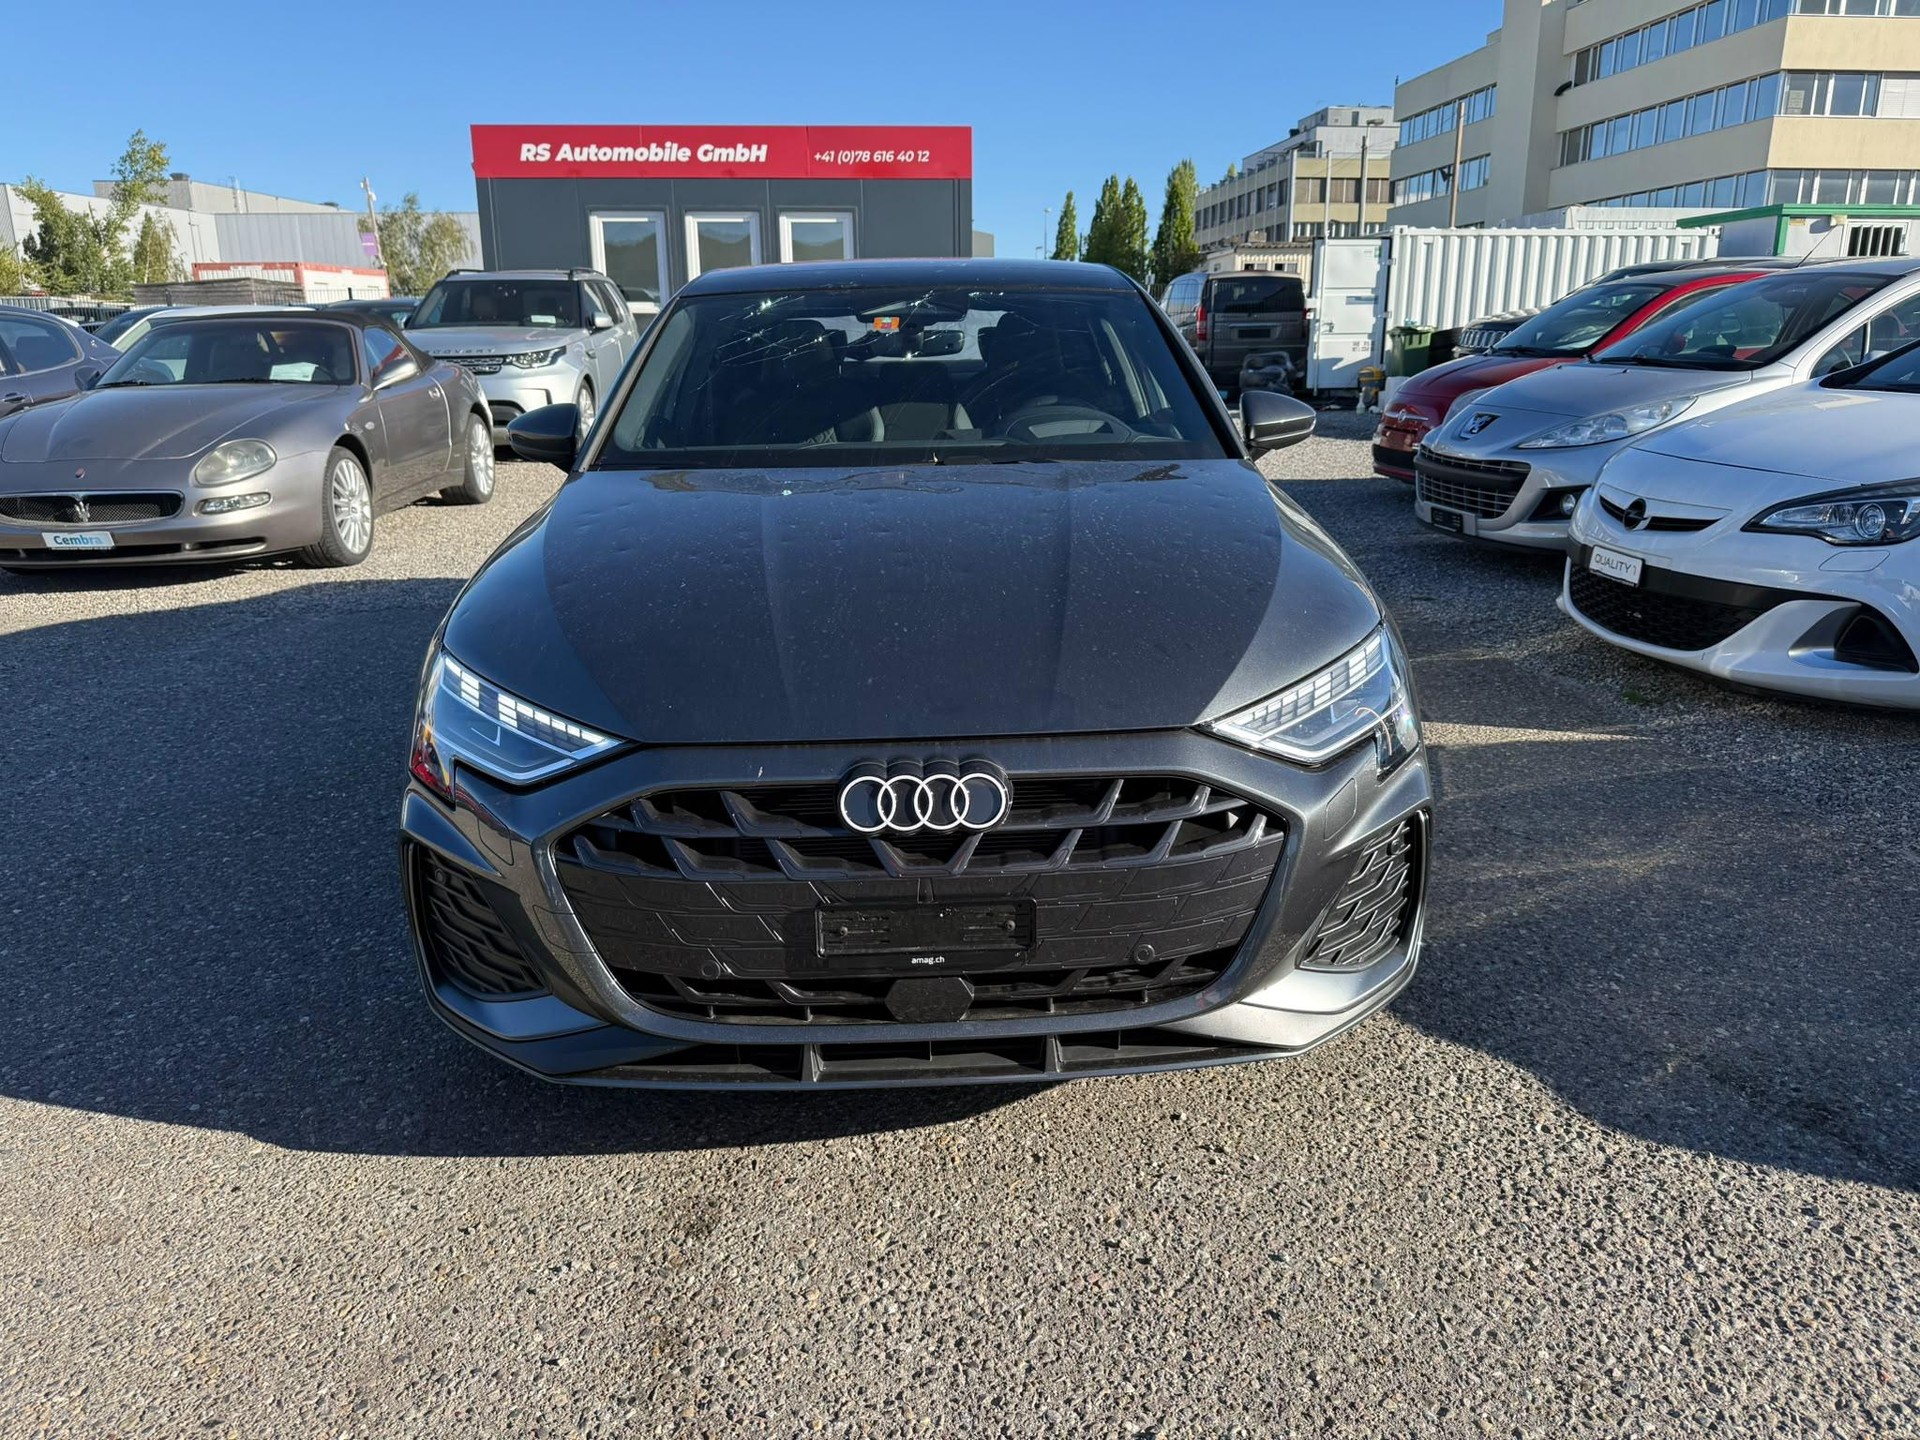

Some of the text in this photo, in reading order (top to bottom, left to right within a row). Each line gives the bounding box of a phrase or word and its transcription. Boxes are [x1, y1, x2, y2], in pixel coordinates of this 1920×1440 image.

[520, 141, 768, 163] RS Automobile GmbH
[814, 150, 930, 165] +41 (0)78 616 40 12
[53, 534, 105, 545] Cembra
[911, 955, 945, 965] amag.ch
